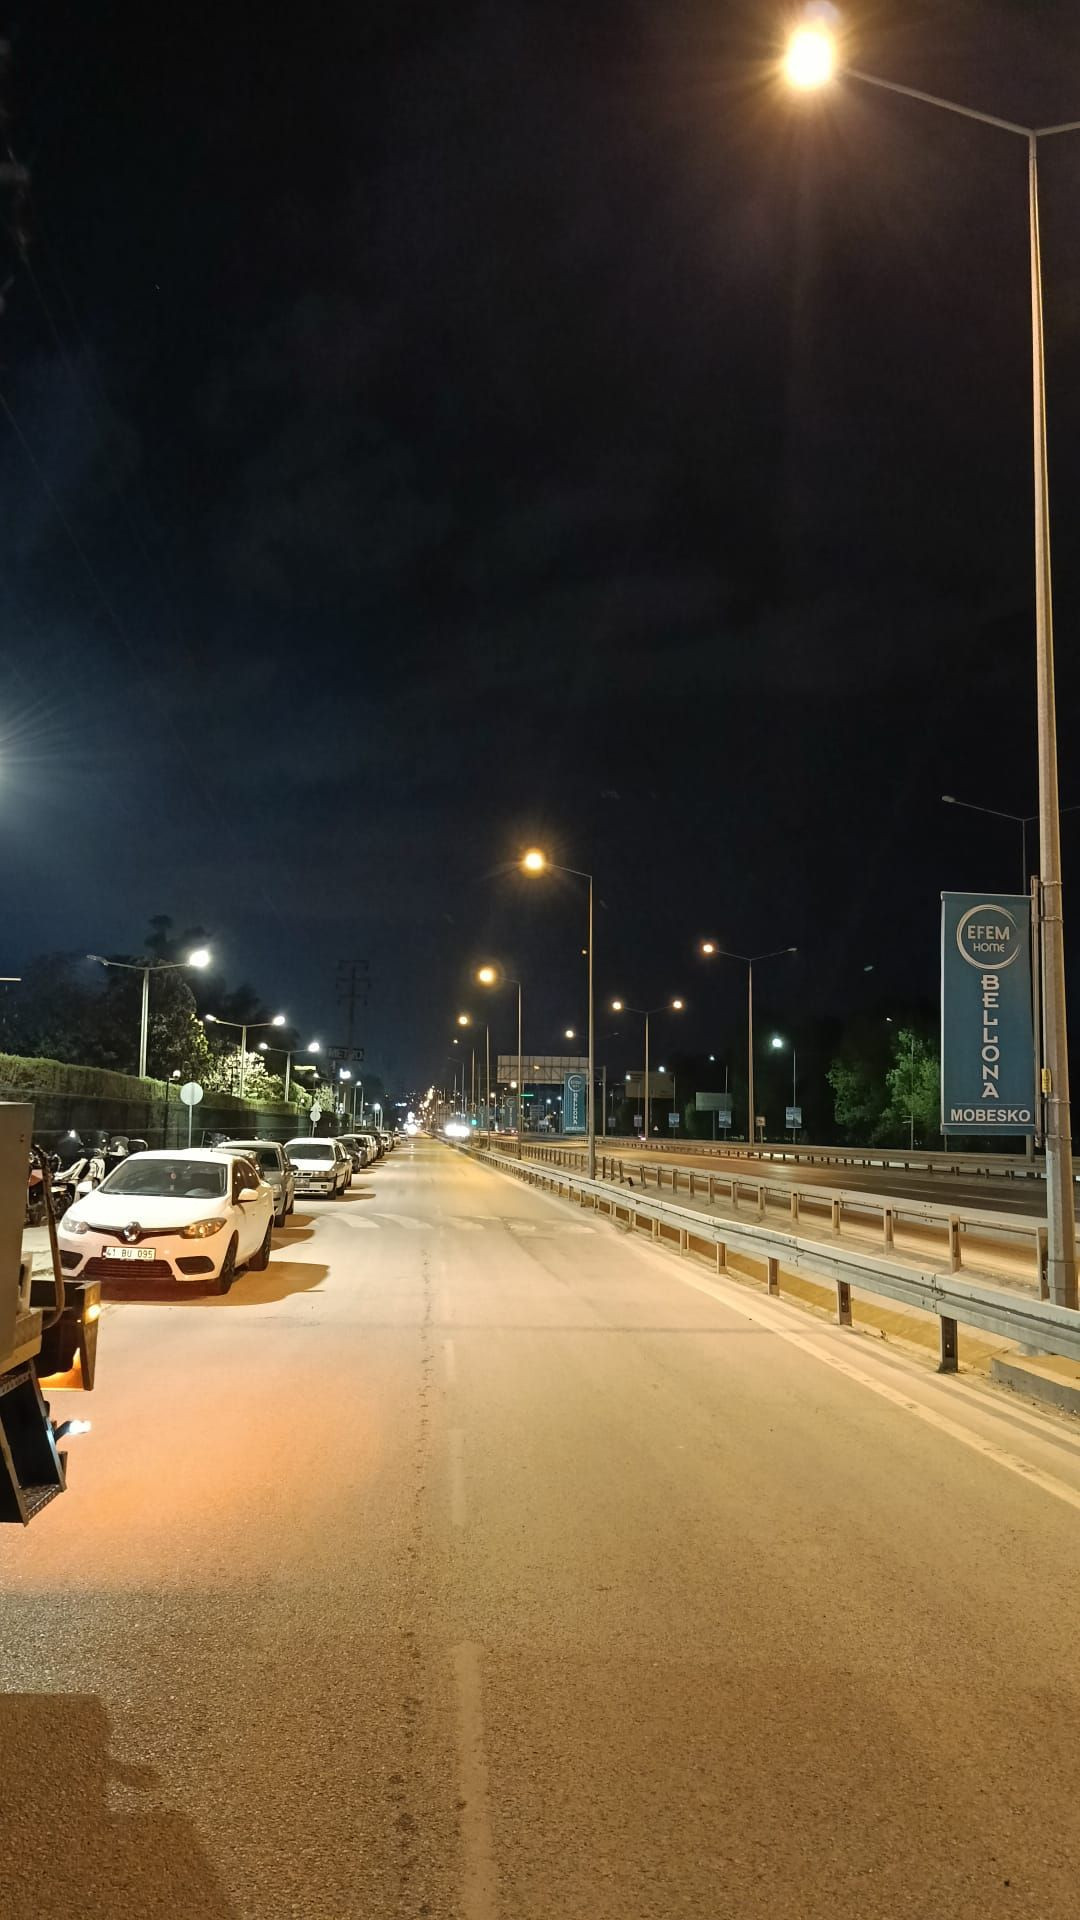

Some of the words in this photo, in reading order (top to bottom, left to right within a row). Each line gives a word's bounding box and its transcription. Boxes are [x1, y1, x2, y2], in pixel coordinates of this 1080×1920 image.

[967, 924, 1010, 941] EFEM
[973, 942, 1005, 953] HOME
[981, 974, 1000, 1098] BELLONA
[950, 1108, 1031, 1123] MOBESKO
[106, 1247, 116, 1257] 41
[121, 1248, 133, 1258] BU
[137, 1249, 153, 1259] 095
